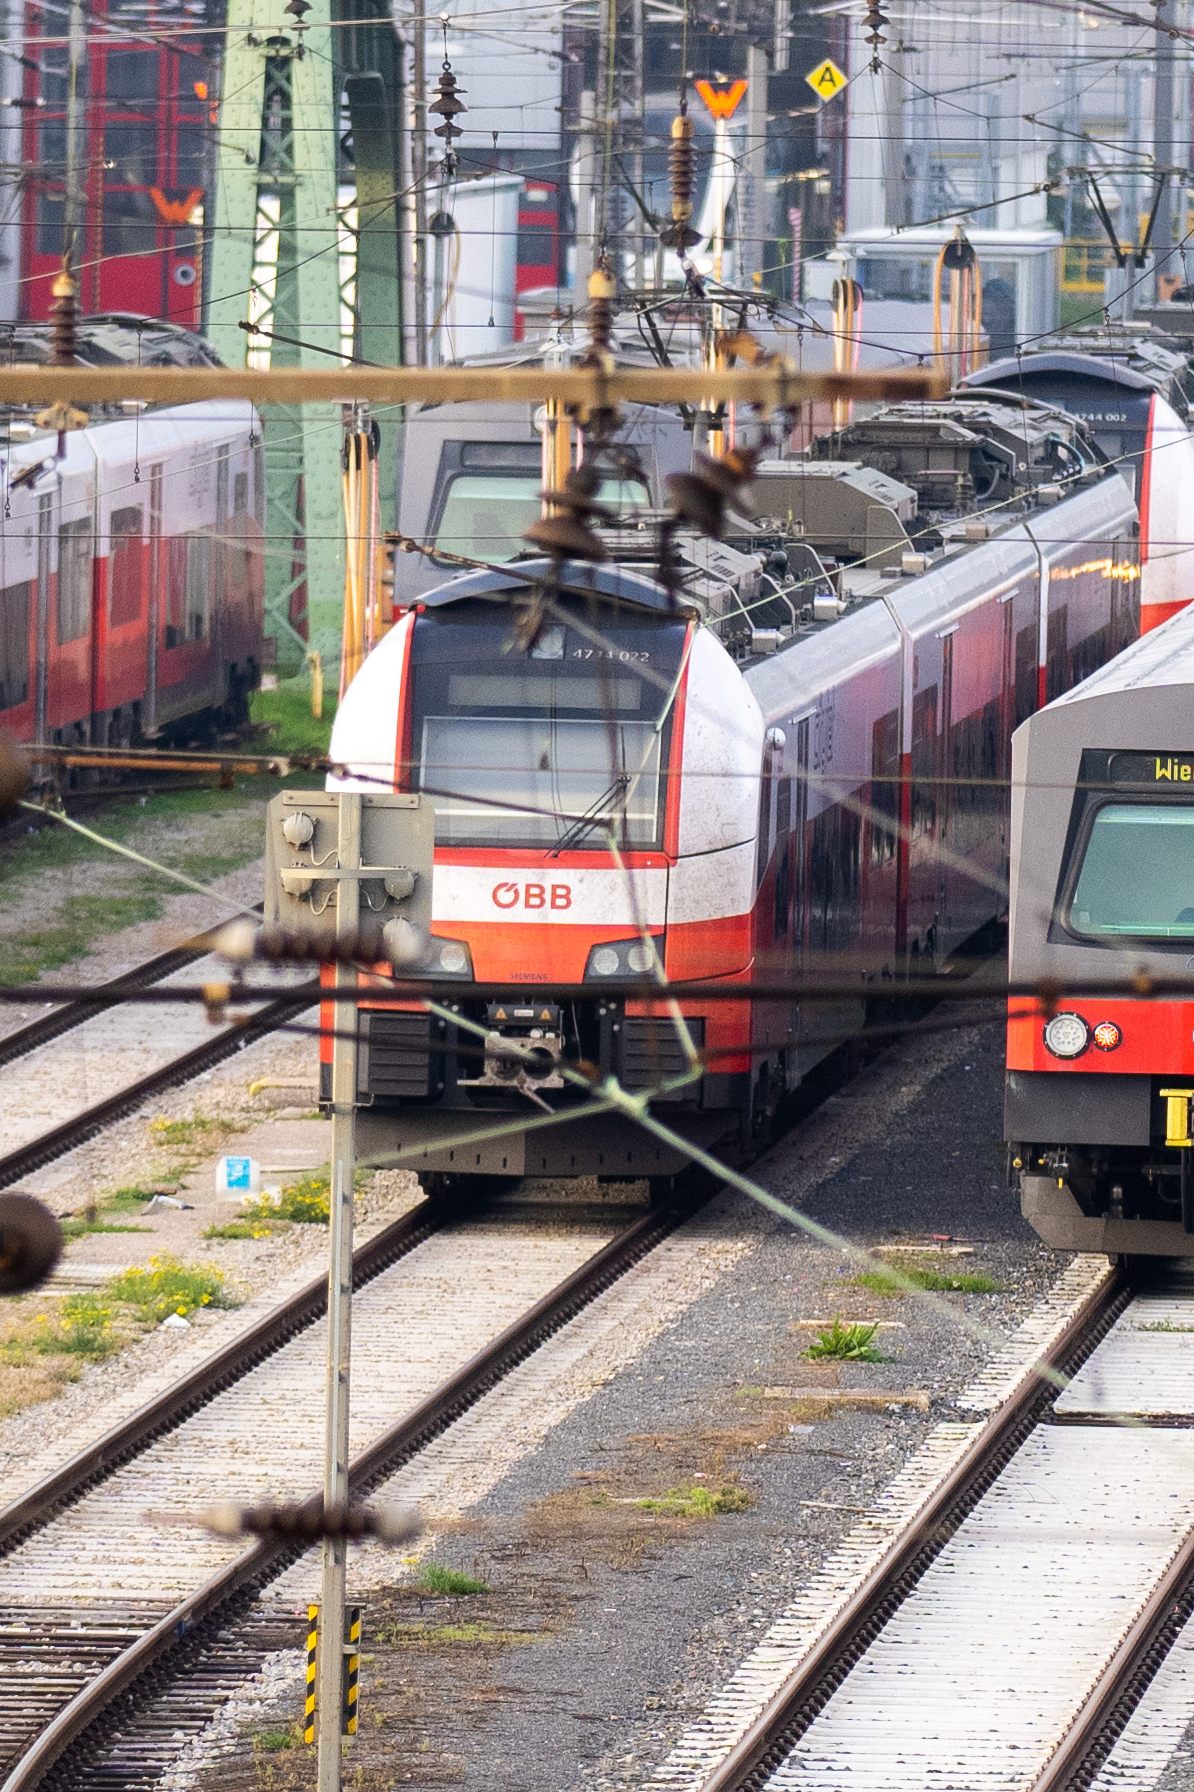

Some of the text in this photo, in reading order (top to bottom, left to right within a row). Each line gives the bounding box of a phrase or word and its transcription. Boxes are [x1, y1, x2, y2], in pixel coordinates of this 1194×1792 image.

[817, 66, 837, 88] A
[619, 651, 650, 662] 022
[492, 882, 573, 910] ÖBB
